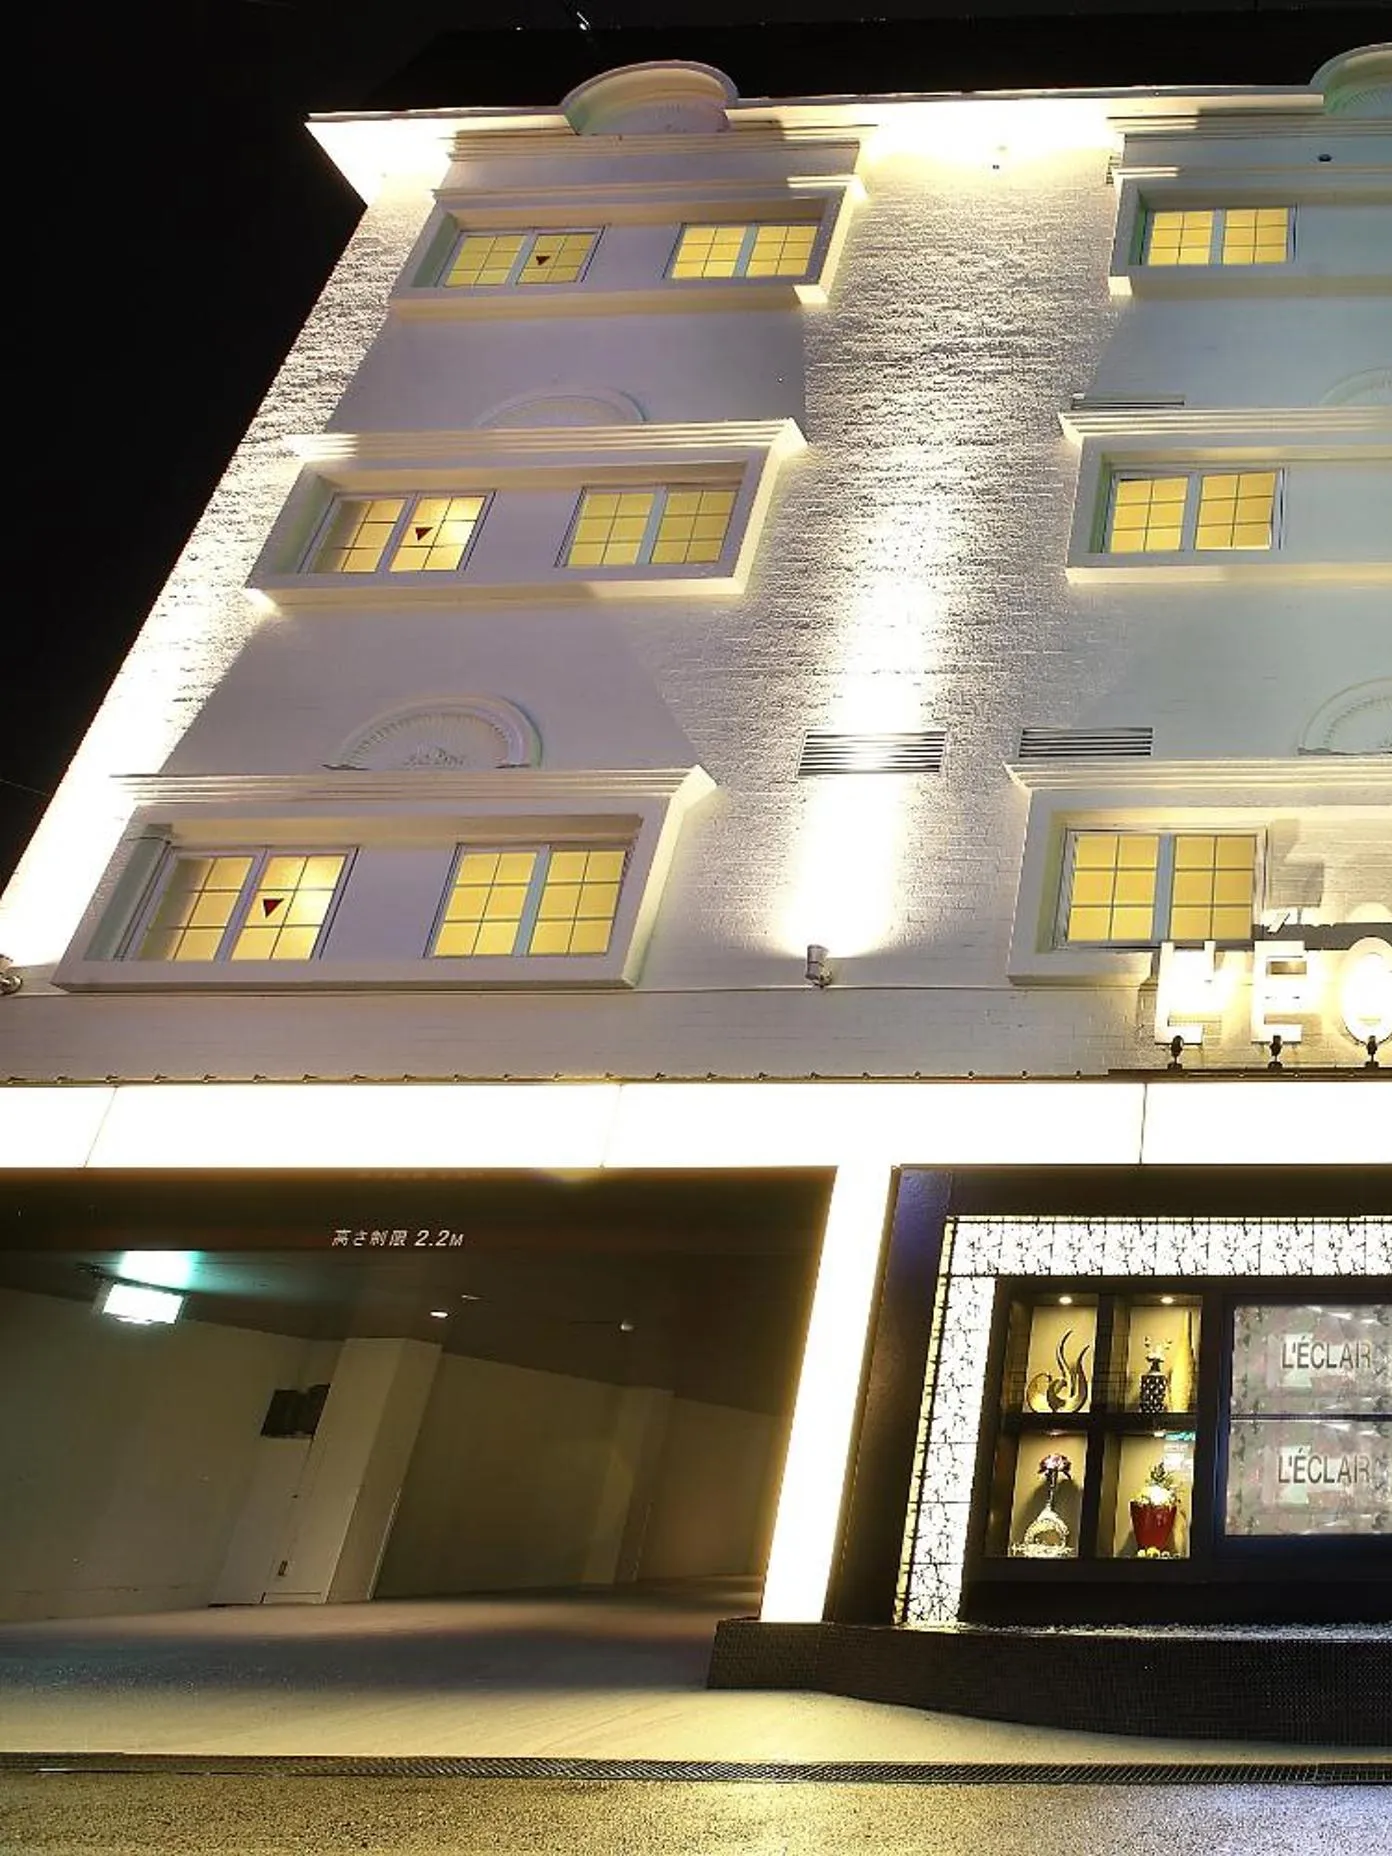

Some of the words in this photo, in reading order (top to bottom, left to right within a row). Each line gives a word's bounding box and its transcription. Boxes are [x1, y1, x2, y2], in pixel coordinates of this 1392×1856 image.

[331, 1229, 408, 1247] 高さ制限
[1281, 1335, 1372, 1369] L'ÉCLAIR
[1278, 1447, 1370, 1484] L'ÉCLAIR
